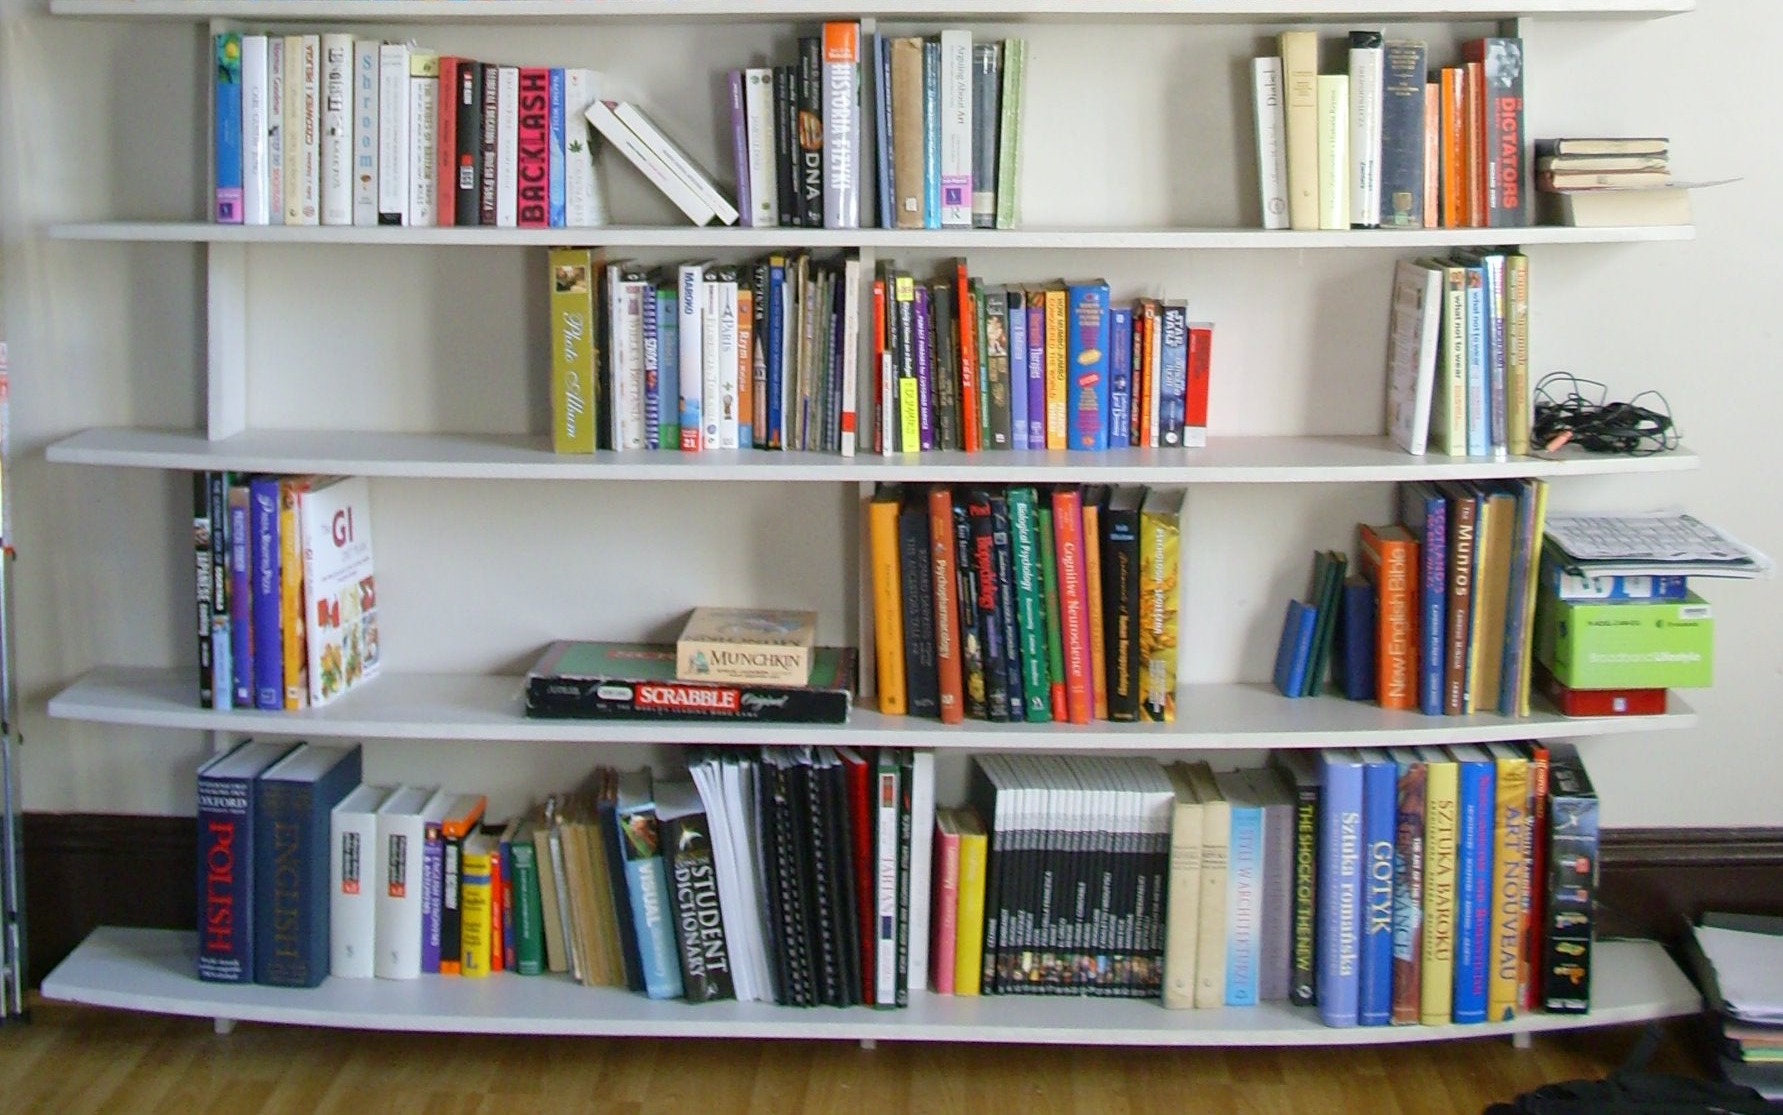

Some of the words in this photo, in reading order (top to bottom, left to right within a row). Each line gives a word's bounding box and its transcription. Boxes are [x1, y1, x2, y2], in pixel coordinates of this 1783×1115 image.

[956, 45, 965, 80] Arguing
[831, 64, 851, 134] HISTORIA
[521, 74, 546, 223] BACKLASH
[1501, 97, 1518, 208] DICTATORS
[805, 152, 820, 200] DNA
[684, 272, 694, 315] MAROKO
[1454, 295, 1462, 321] what
[563, 311, 583, 363] Photo
[1165, 310, 1176, 347] WARS
[1174, 312, 1184, 346] STAR
[1454, 323, 1462, 339] not
[1454, 341, 1462, 352] to
[1454, 354, 1462, 379] wear
[565, 371, 585, 439] Album
[1016, 502, 1030, 544] Biological
[196, 551, 209, 602] JAPANESE
[1018, 545, 1033, 592] Psychology
[1062, 542, 1078, 598] Cognitive
[1388, 548, 1406, 590] Bible
[1455, 524, 1474, 596] Munros
[1068, 600, 1083, 678] Neuroscience
[1389, 592, 1411, 655] English
[710, 649, 800, 668] MUNCHKIN
[1390, 657, 1406, 698] New
[639, 686, 736, 708] SCRABBLE
[1299, 805, 1311, 829] THE
[1437, 800, 1453, 876] SZTUKA
[1503, 805, 1520, 856] ART
[1298, 834, 1311, 883] SHOCK
[1341, 812, 1360, 876] Sztuka
[207, 820, 235, 952] POLISH
[274, 821, 298, 958] ENGLISH
[638, 861, 660, 928] VISUAL
[1298, 886, 1310, 905] OF
[1371, 841, 1393, 934] GOTYK
[674, 867, 705, 977] DICTIONARY
[690, 865, 728, 974] STUDENT
[1297, 909, 1310, 934] THE
[1339, 883, 1358, 976] romańska
[1435, 883, 1452, 961] BAROKU
[1500, 861, 1519, 981] NOUVEAU
[1297, 937, 1309, 971] NEW
